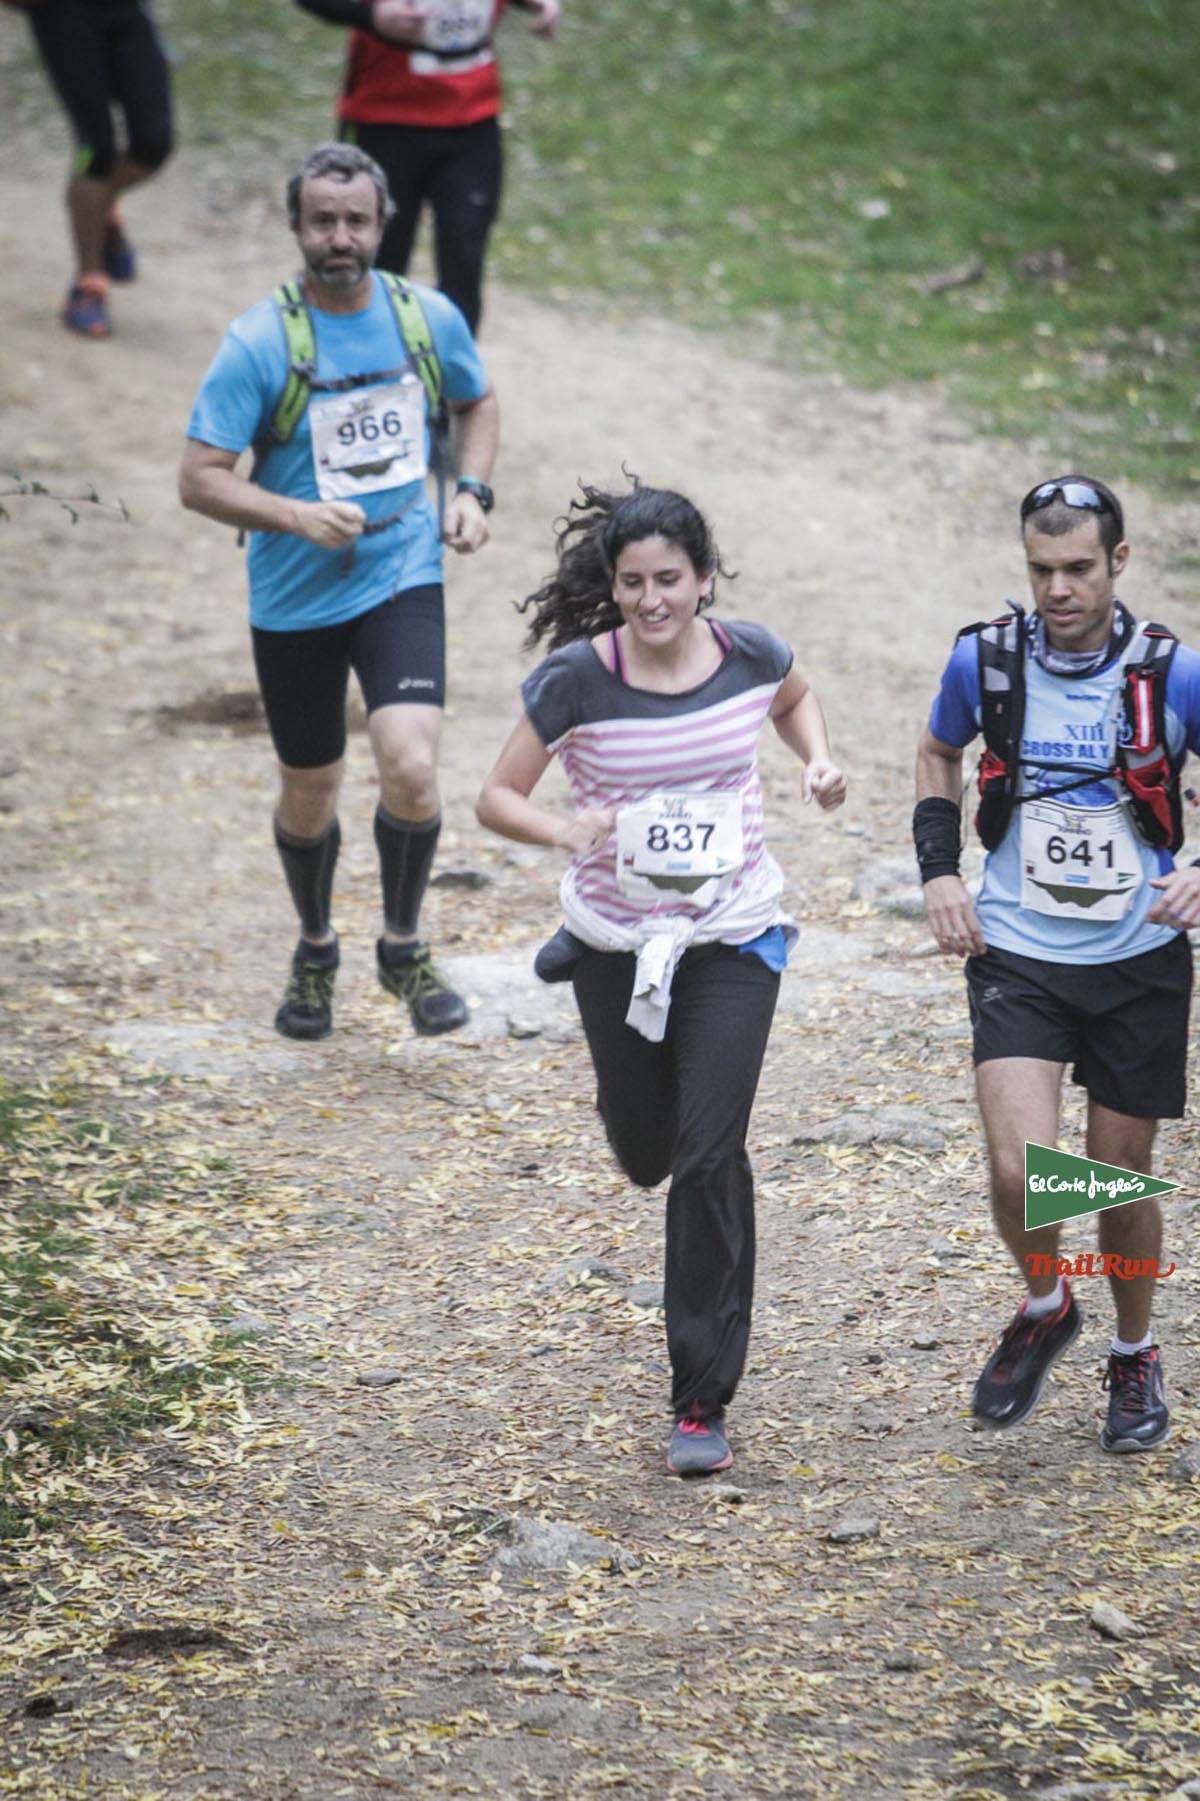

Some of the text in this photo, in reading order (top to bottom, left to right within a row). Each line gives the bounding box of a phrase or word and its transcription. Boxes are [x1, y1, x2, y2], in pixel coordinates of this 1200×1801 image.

[336, 410, 402, 446] 966
[1078, 743, 1096, 759] AL
[646, 823, 716, 853] 837
[1046, 834, 1114, 869] 641
